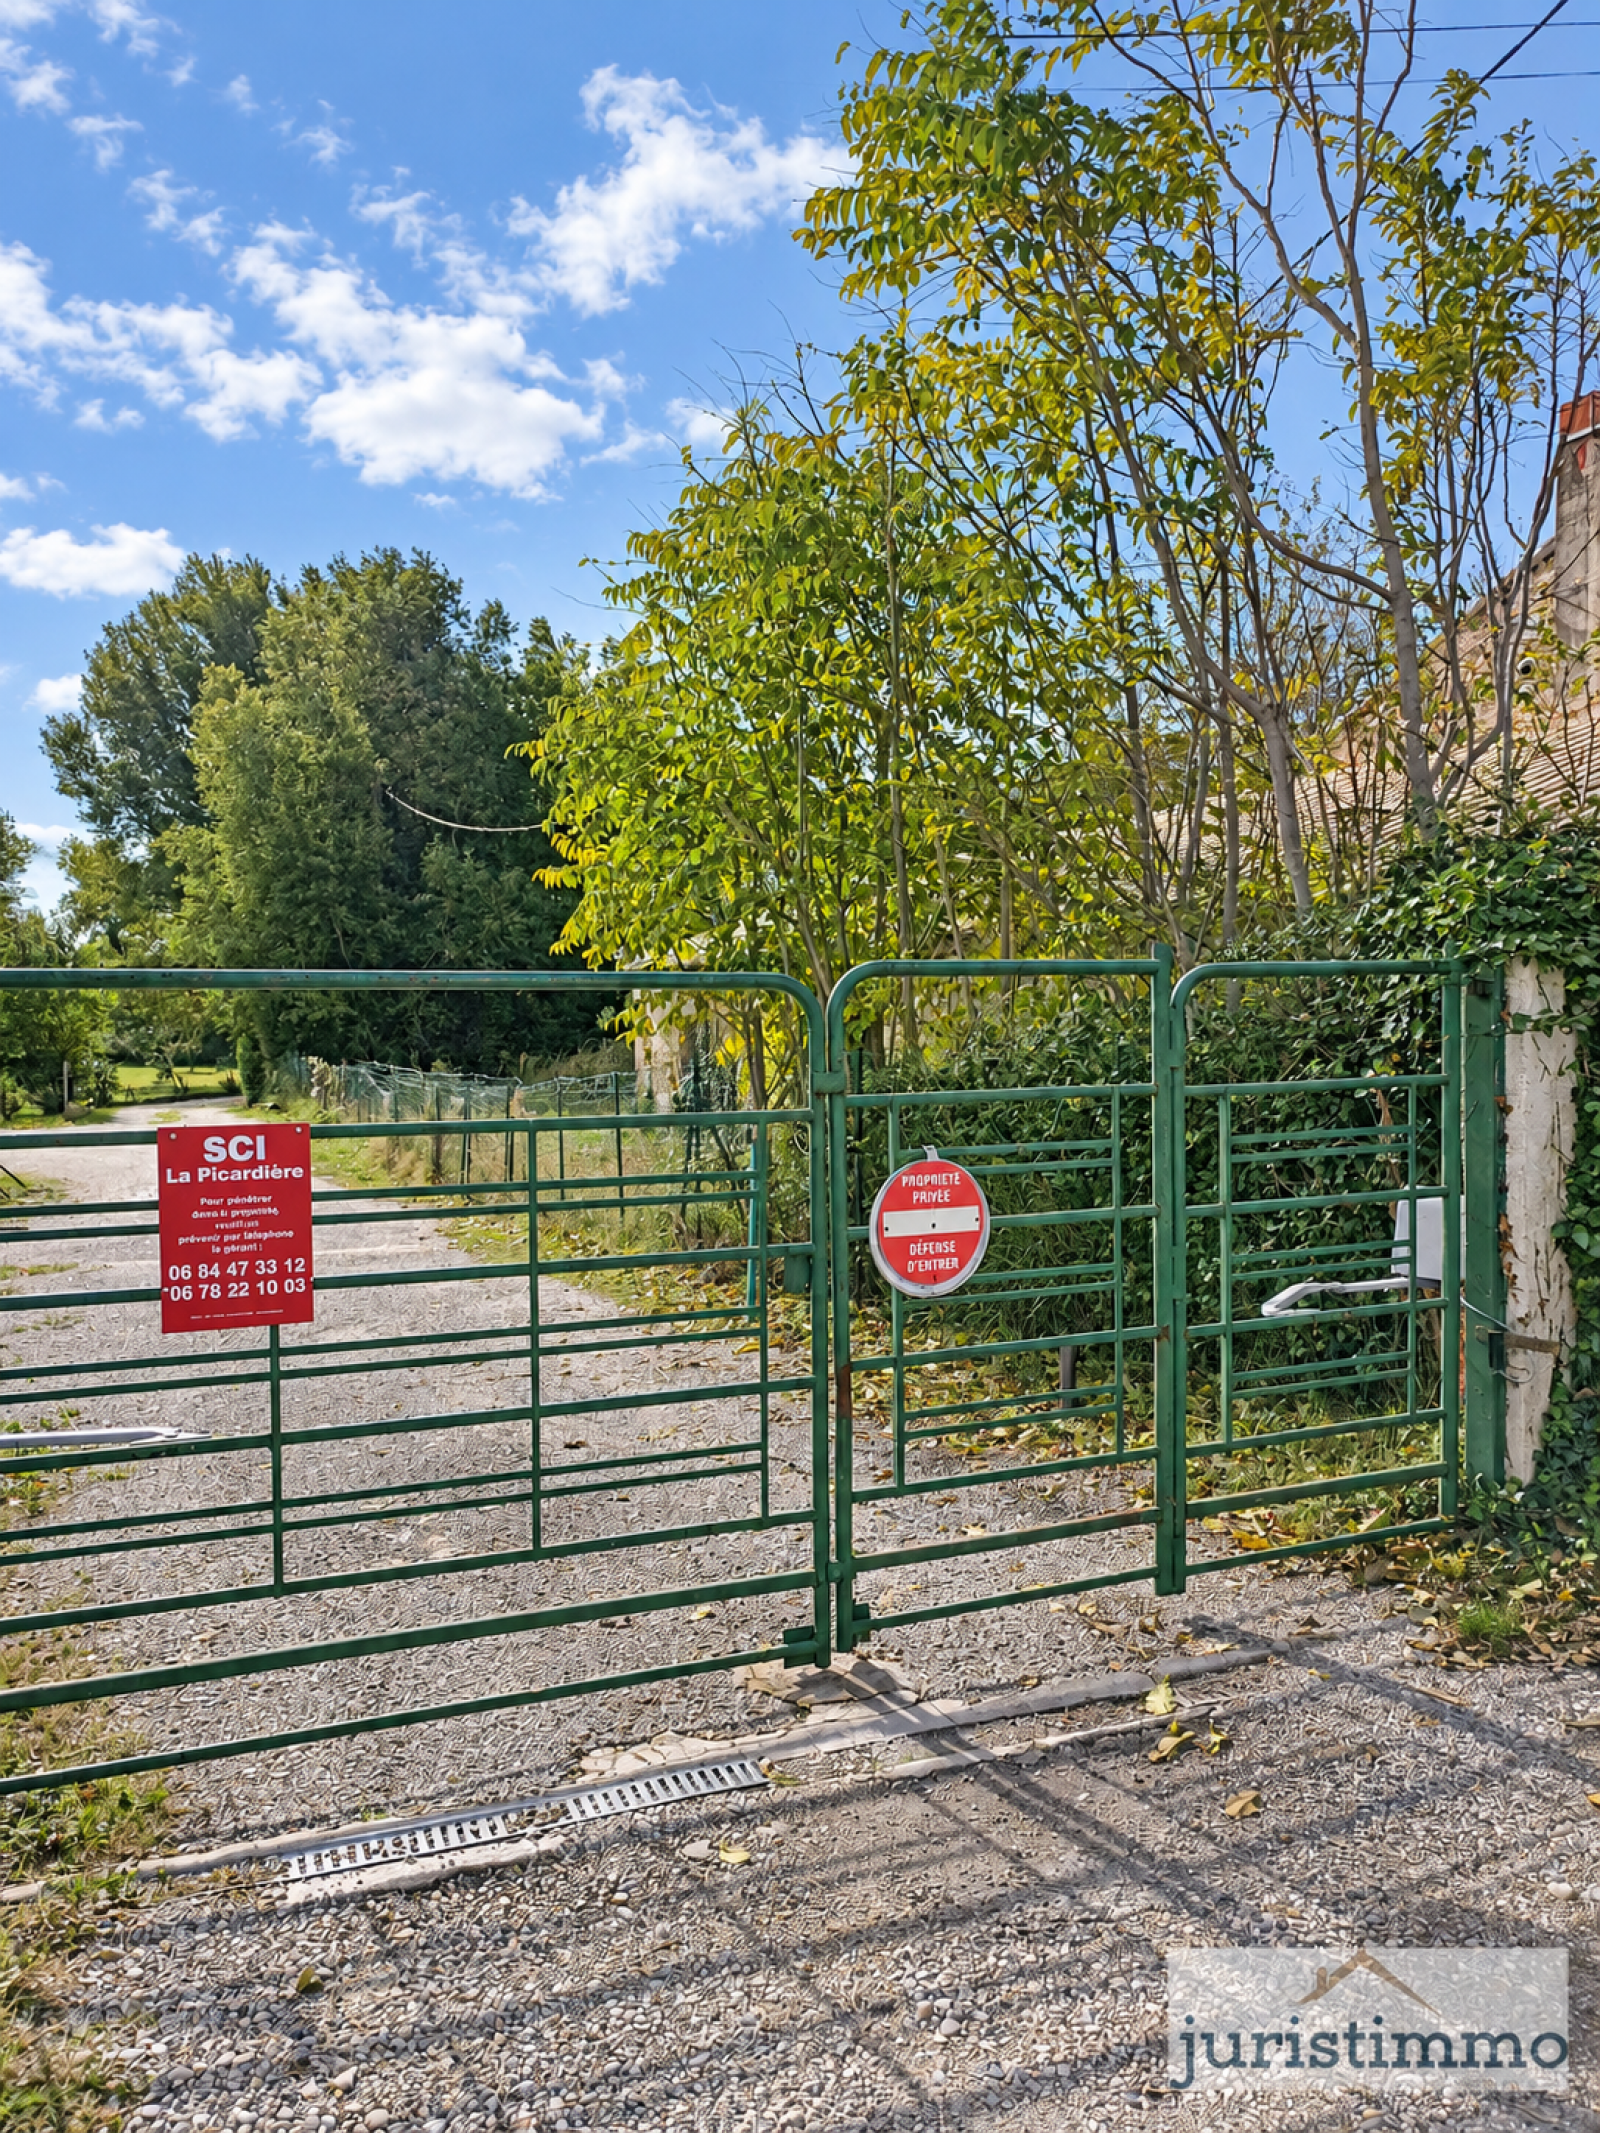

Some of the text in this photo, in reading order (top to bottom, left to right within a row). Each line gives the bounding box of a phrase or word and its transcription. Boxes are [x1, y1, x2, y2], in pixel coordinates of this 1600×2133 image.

[203, 1135, 266, 1163] SCI
[166, 1163, 304, 1184] La Picardière
[200, 1197, 224, 1206] Pour
[168, 1257, 306, 1281] 06 84 47 33 12
[907, 1257, 960, 1274] D'ENTRER
[169, 1277, 307, 1302] 06 78 22 10 03
